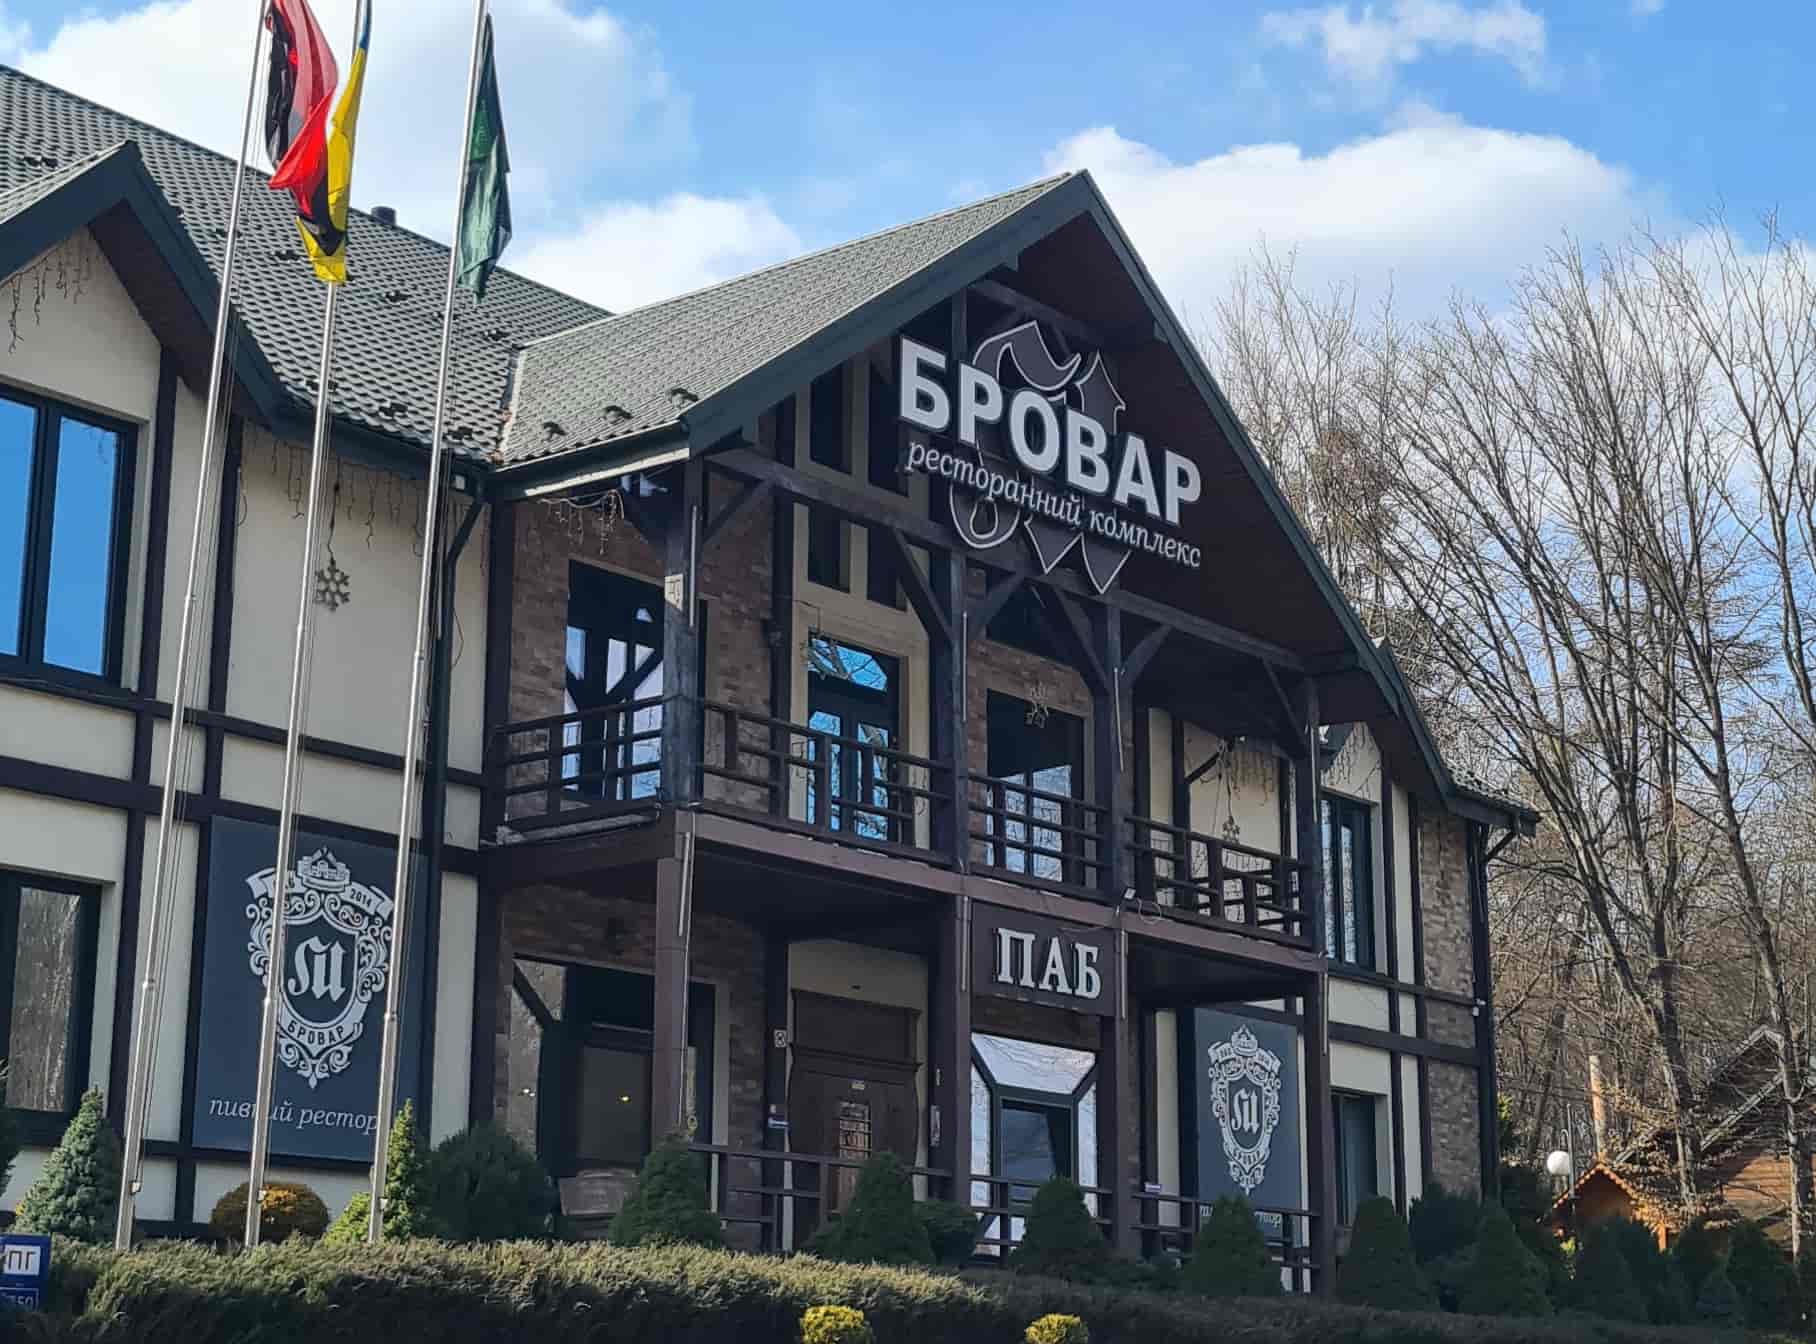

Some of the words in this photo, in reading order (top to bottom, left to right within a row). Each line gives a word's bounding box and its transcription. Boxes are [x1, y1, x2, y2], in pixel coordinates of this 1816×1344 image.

[901, 338, 1202, 528] БРОВАР
[905, 441, 1082, 526] ресторанний
[1089, 507, 1201, 568] комплекс
[997, 927, 1102, 999] ПАБ
[287, 1019, 344, 1045] БРОВАР
[296, 1108, 378, 1136] рестор
